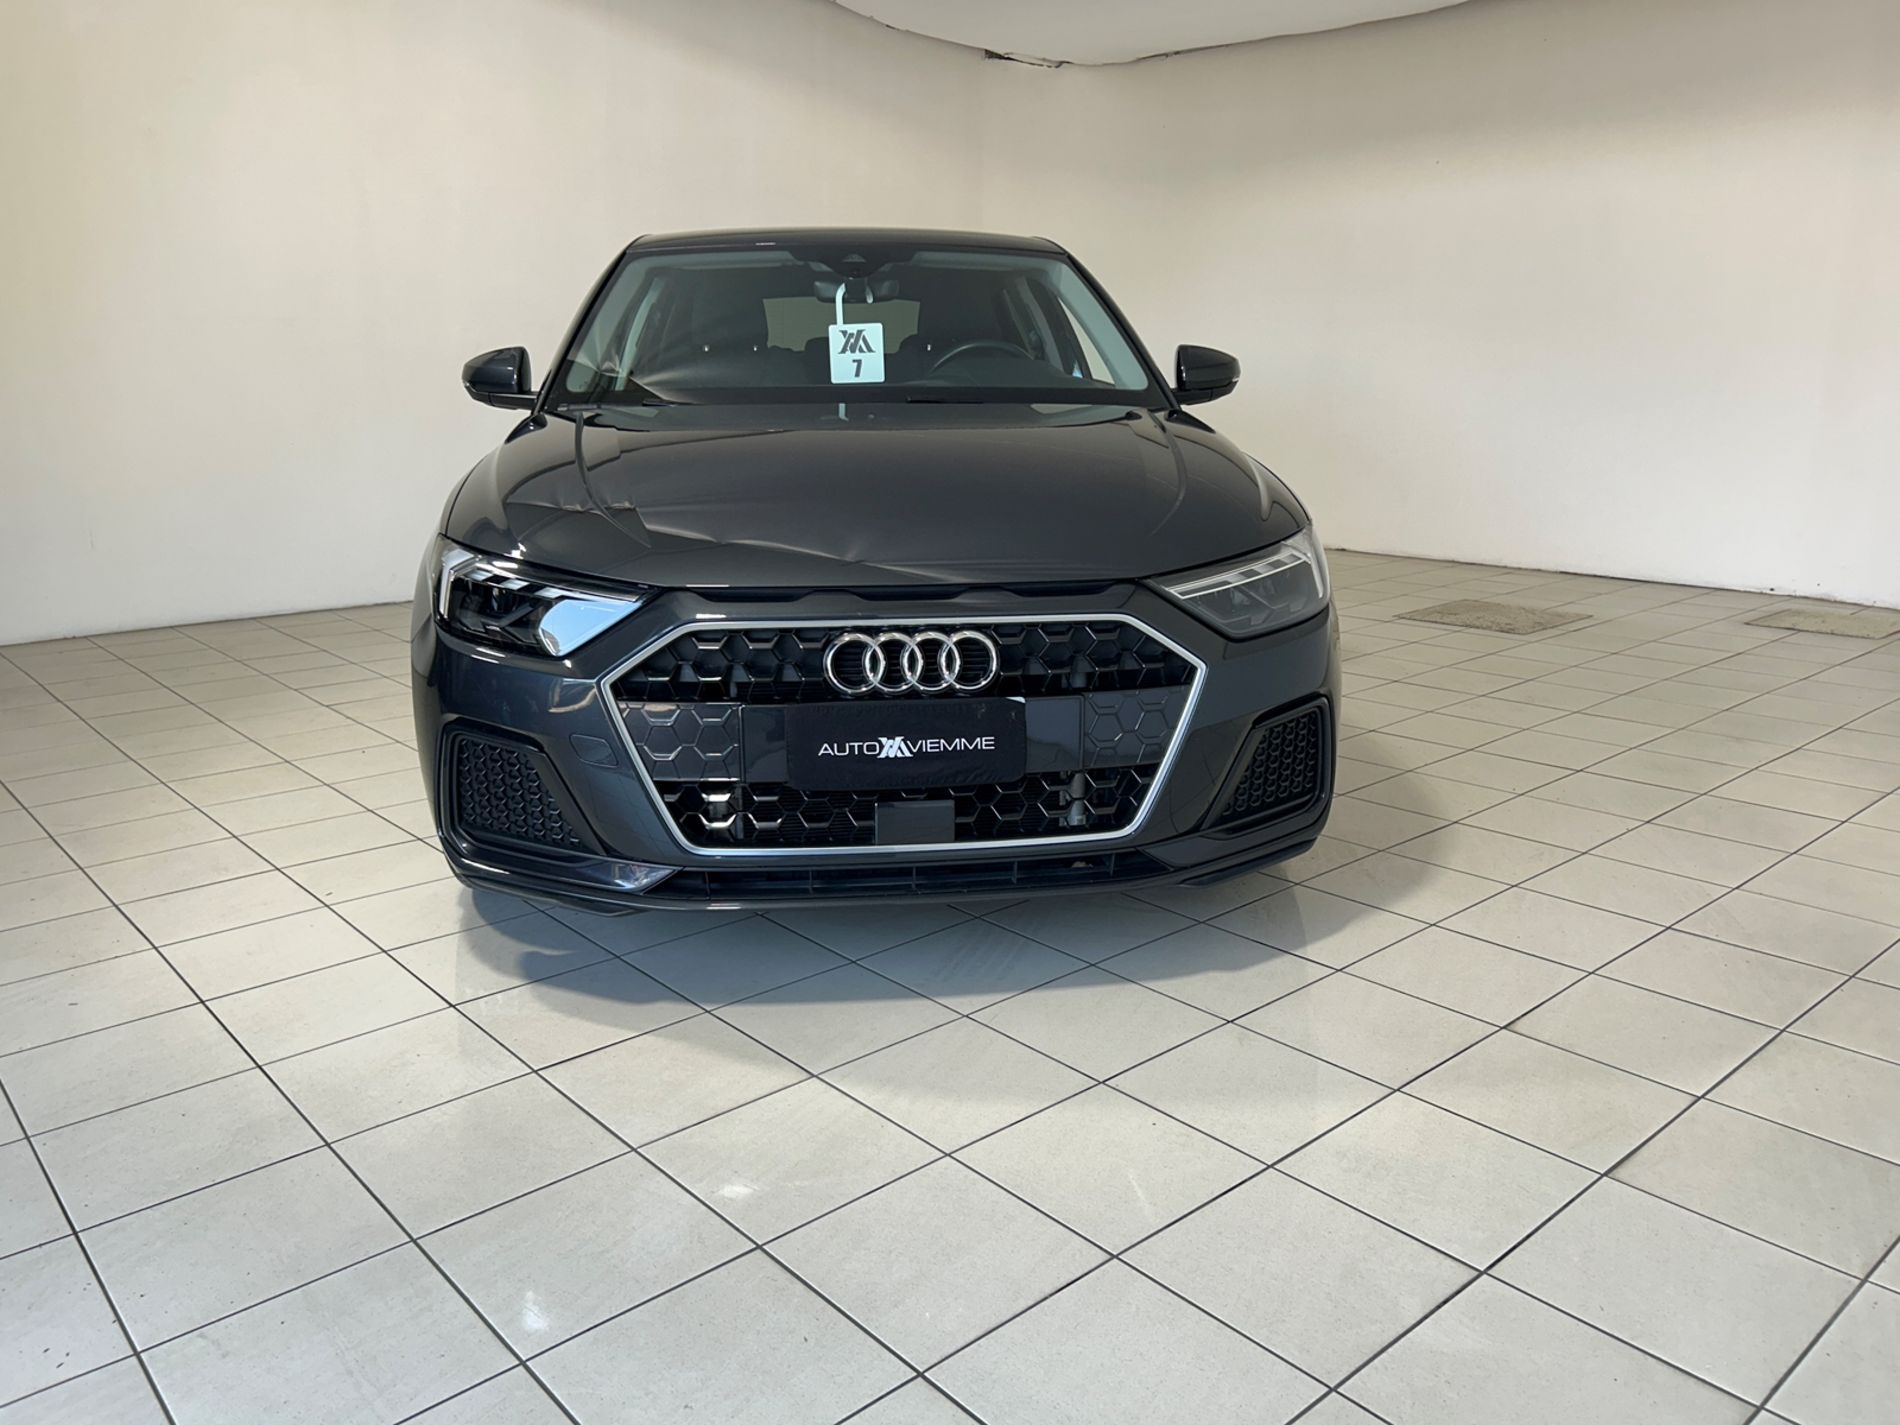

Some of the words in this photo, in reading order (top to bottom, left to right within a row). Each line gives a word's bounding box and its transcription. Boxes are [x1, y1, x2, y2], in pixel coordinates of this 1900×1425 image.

[852, 359, 862, 377] 7
[818, 741, 879, 756] AUTO
[907, 736, 996, 753] VIEMME
